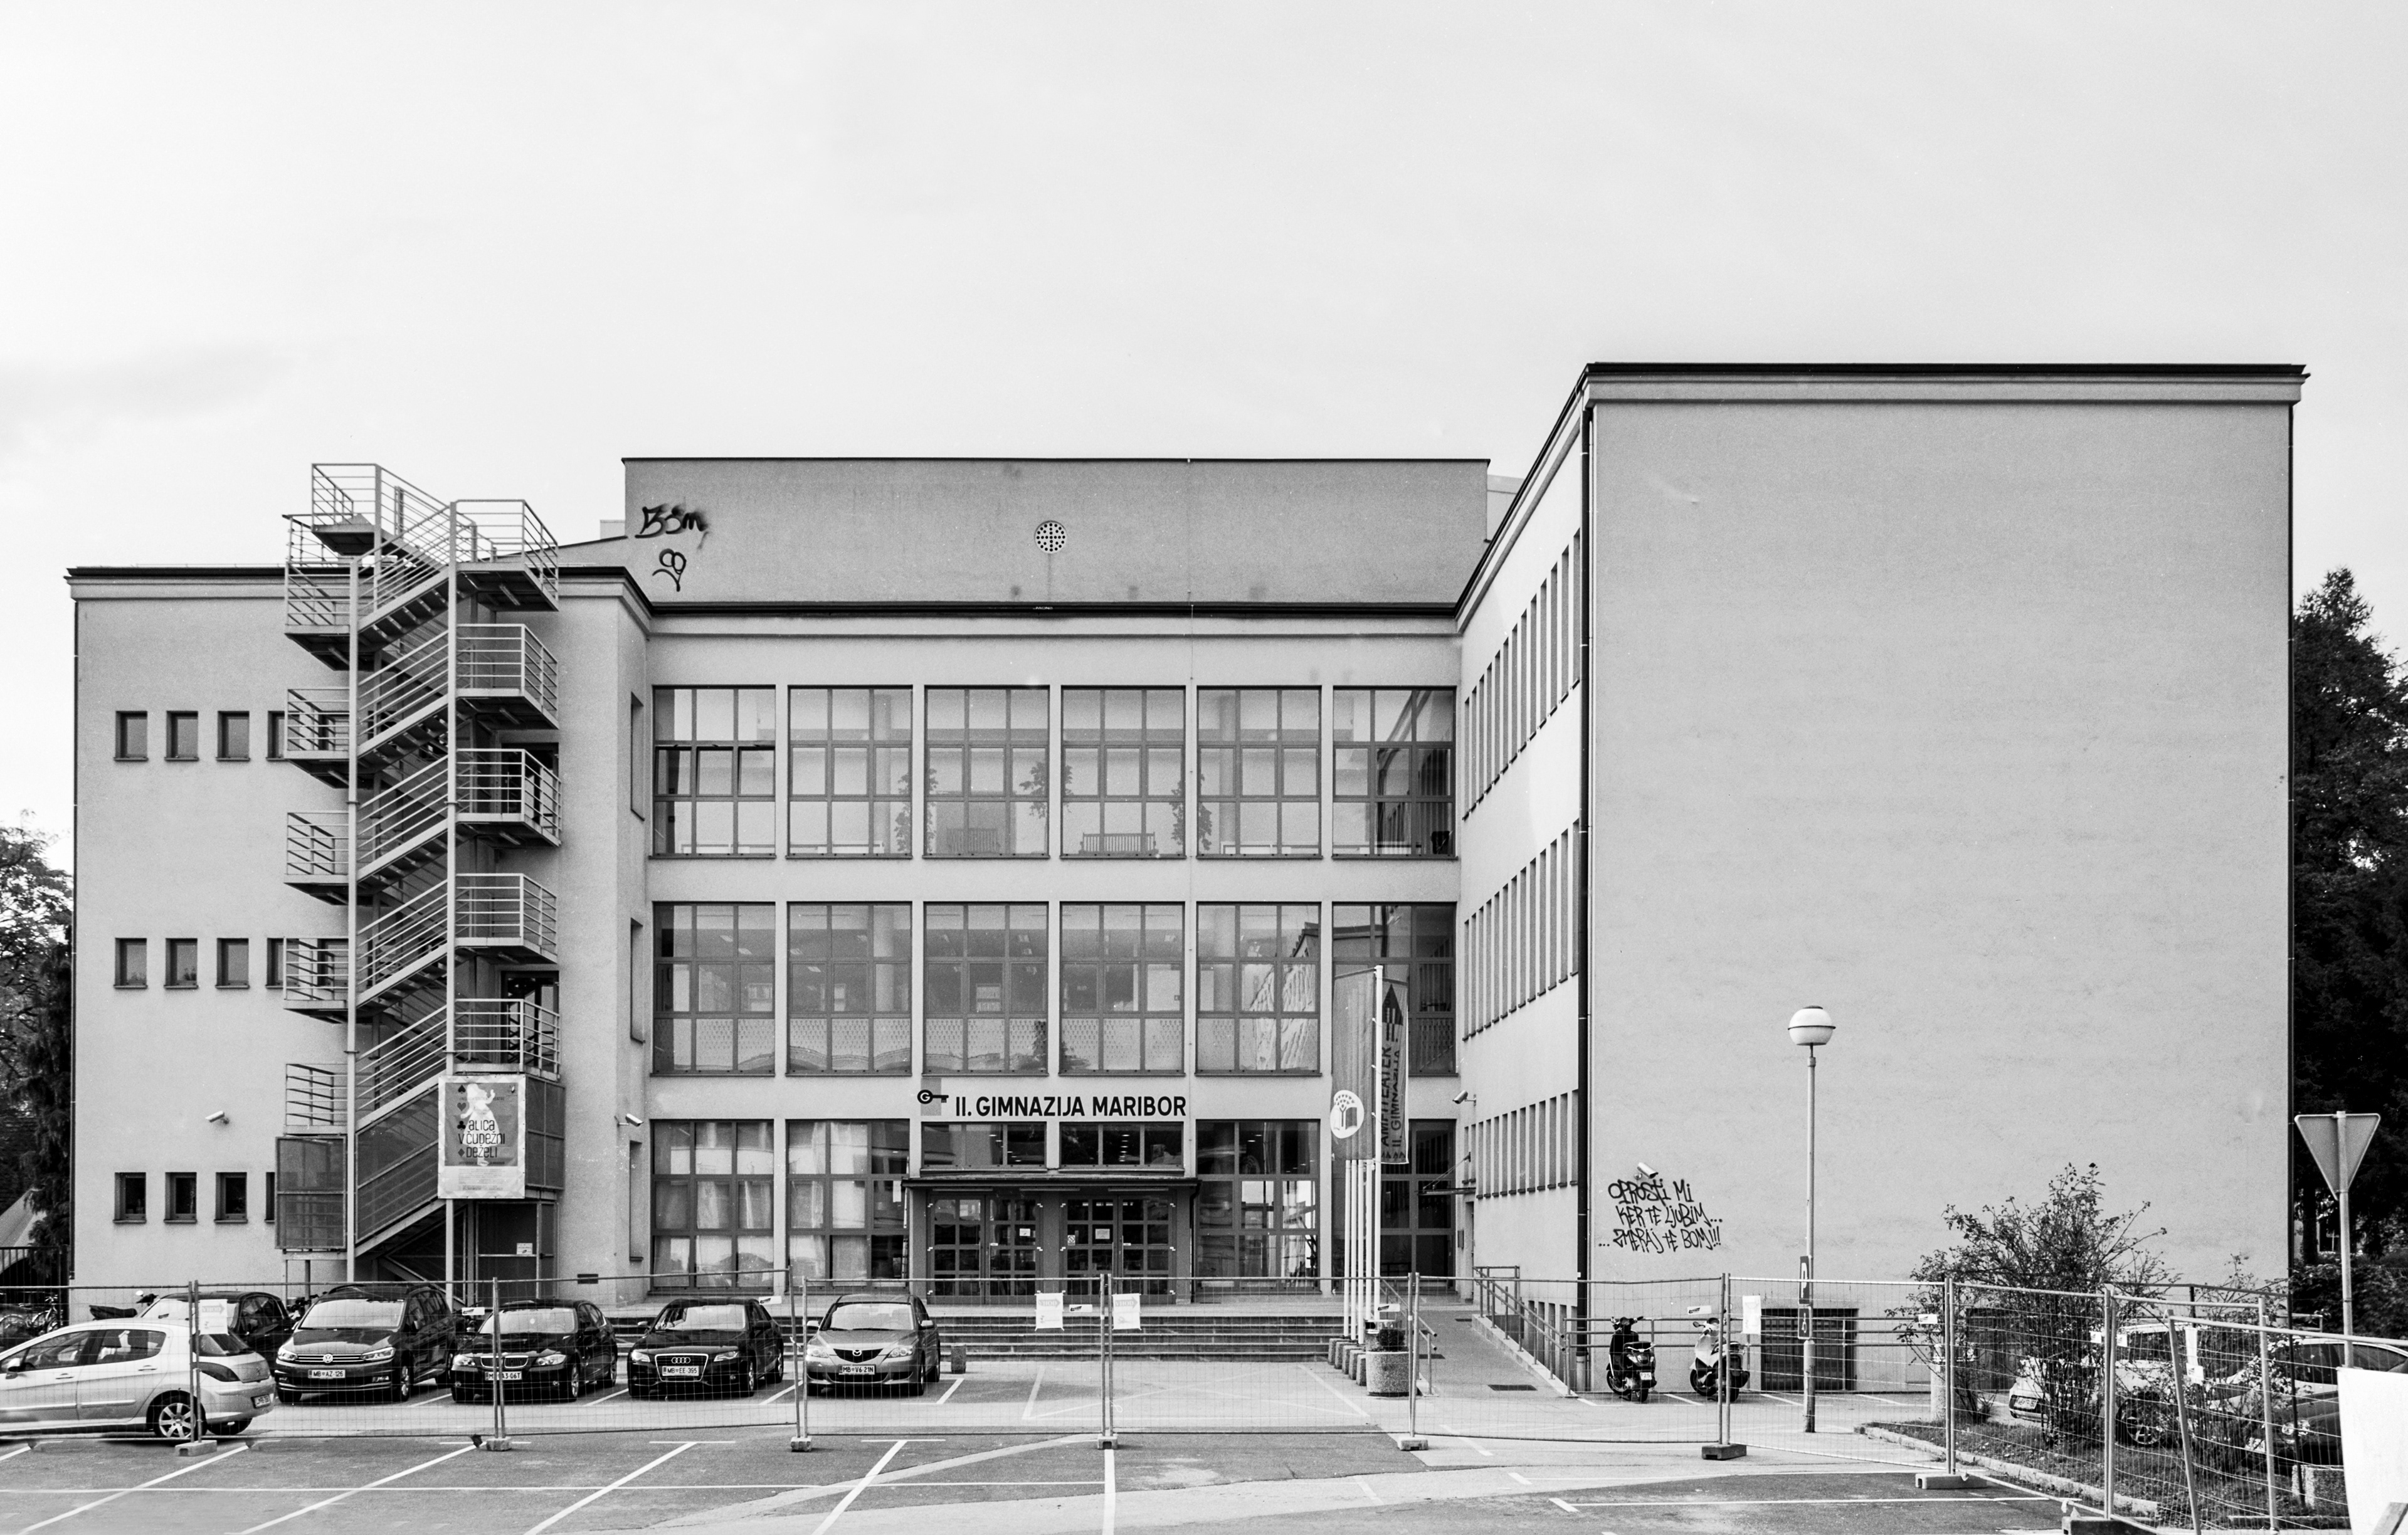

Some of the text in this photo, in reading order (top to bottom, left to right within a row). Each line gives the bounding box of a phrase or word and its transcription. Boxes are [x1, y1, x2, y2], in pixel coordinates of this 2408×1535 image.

[956, 1096, 1186, 1117] II. GIMNAZIJA MARIBOR
[1615, 1205, 1646, 1228] KER
[1645, 1205, 1662, 1226] TE
[1662, 1229, 1679, 1252] TE
[1801, 1262, 1807, 1298] P
